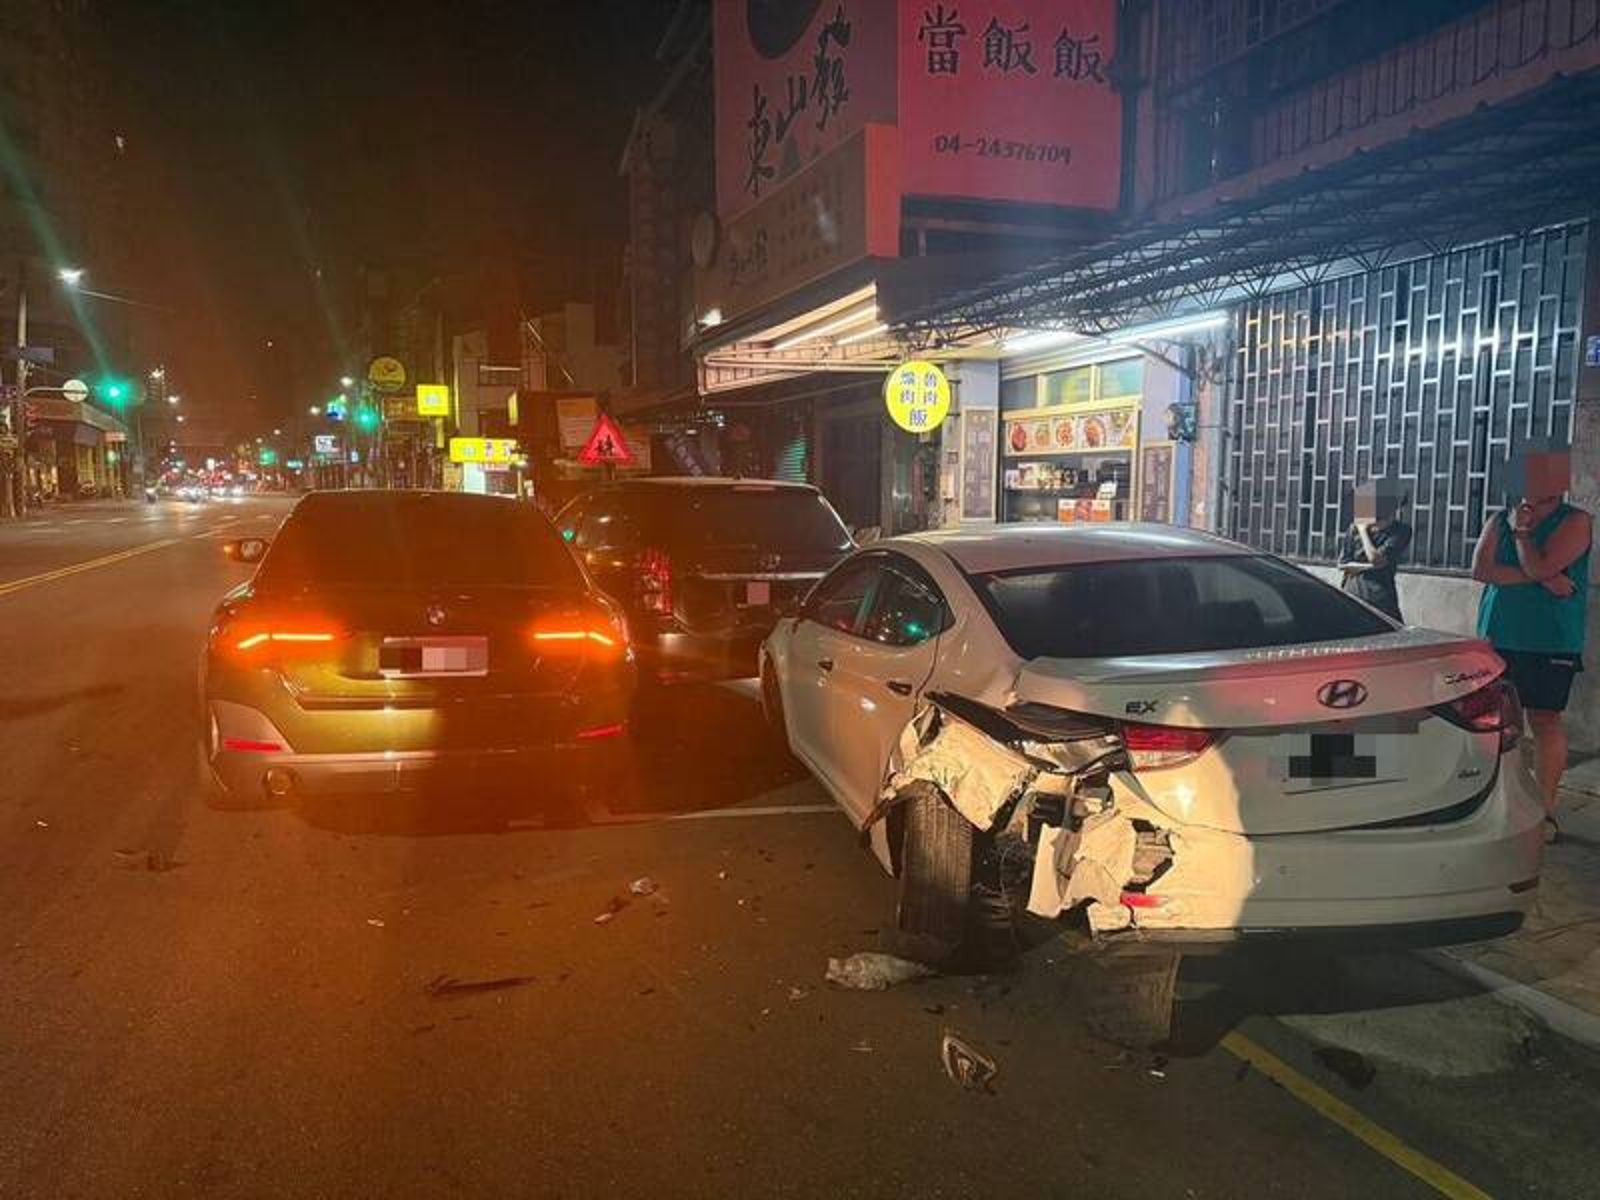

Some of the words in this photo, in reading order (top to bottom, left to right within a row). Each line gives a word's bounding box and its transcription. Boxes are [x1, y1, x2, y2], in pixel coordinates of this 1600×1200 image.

[918, 4, 1104, 84] 當飯飯
[1126, 699, 1159, 715] EX
